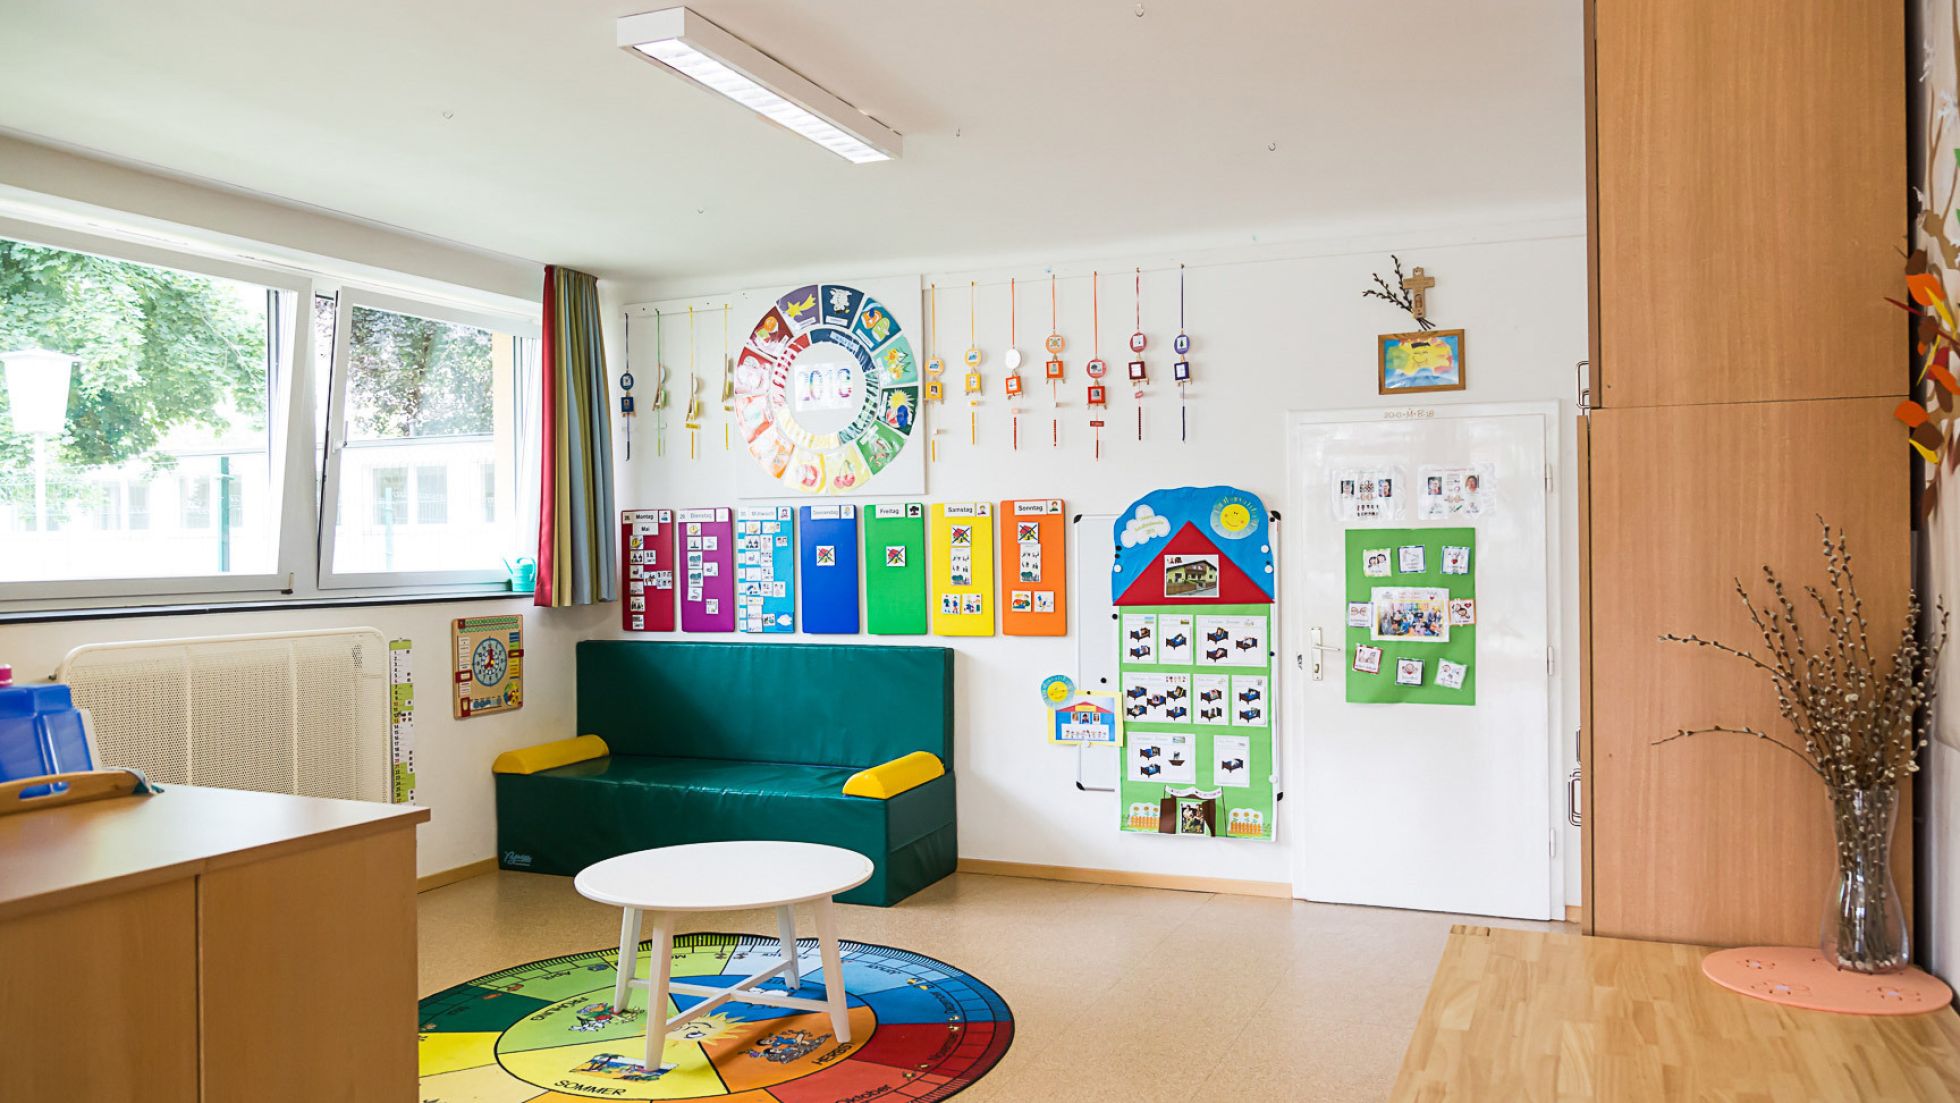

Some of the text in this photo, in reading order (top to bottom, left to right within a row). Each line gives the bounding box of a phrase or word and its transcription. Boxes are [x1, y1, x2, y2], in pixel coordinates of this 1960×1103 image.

[948, 506, 973, 514] Samstag
[635, 513, 654, 521] Montag
[554, 1079, 627, 1096] SOMMER
